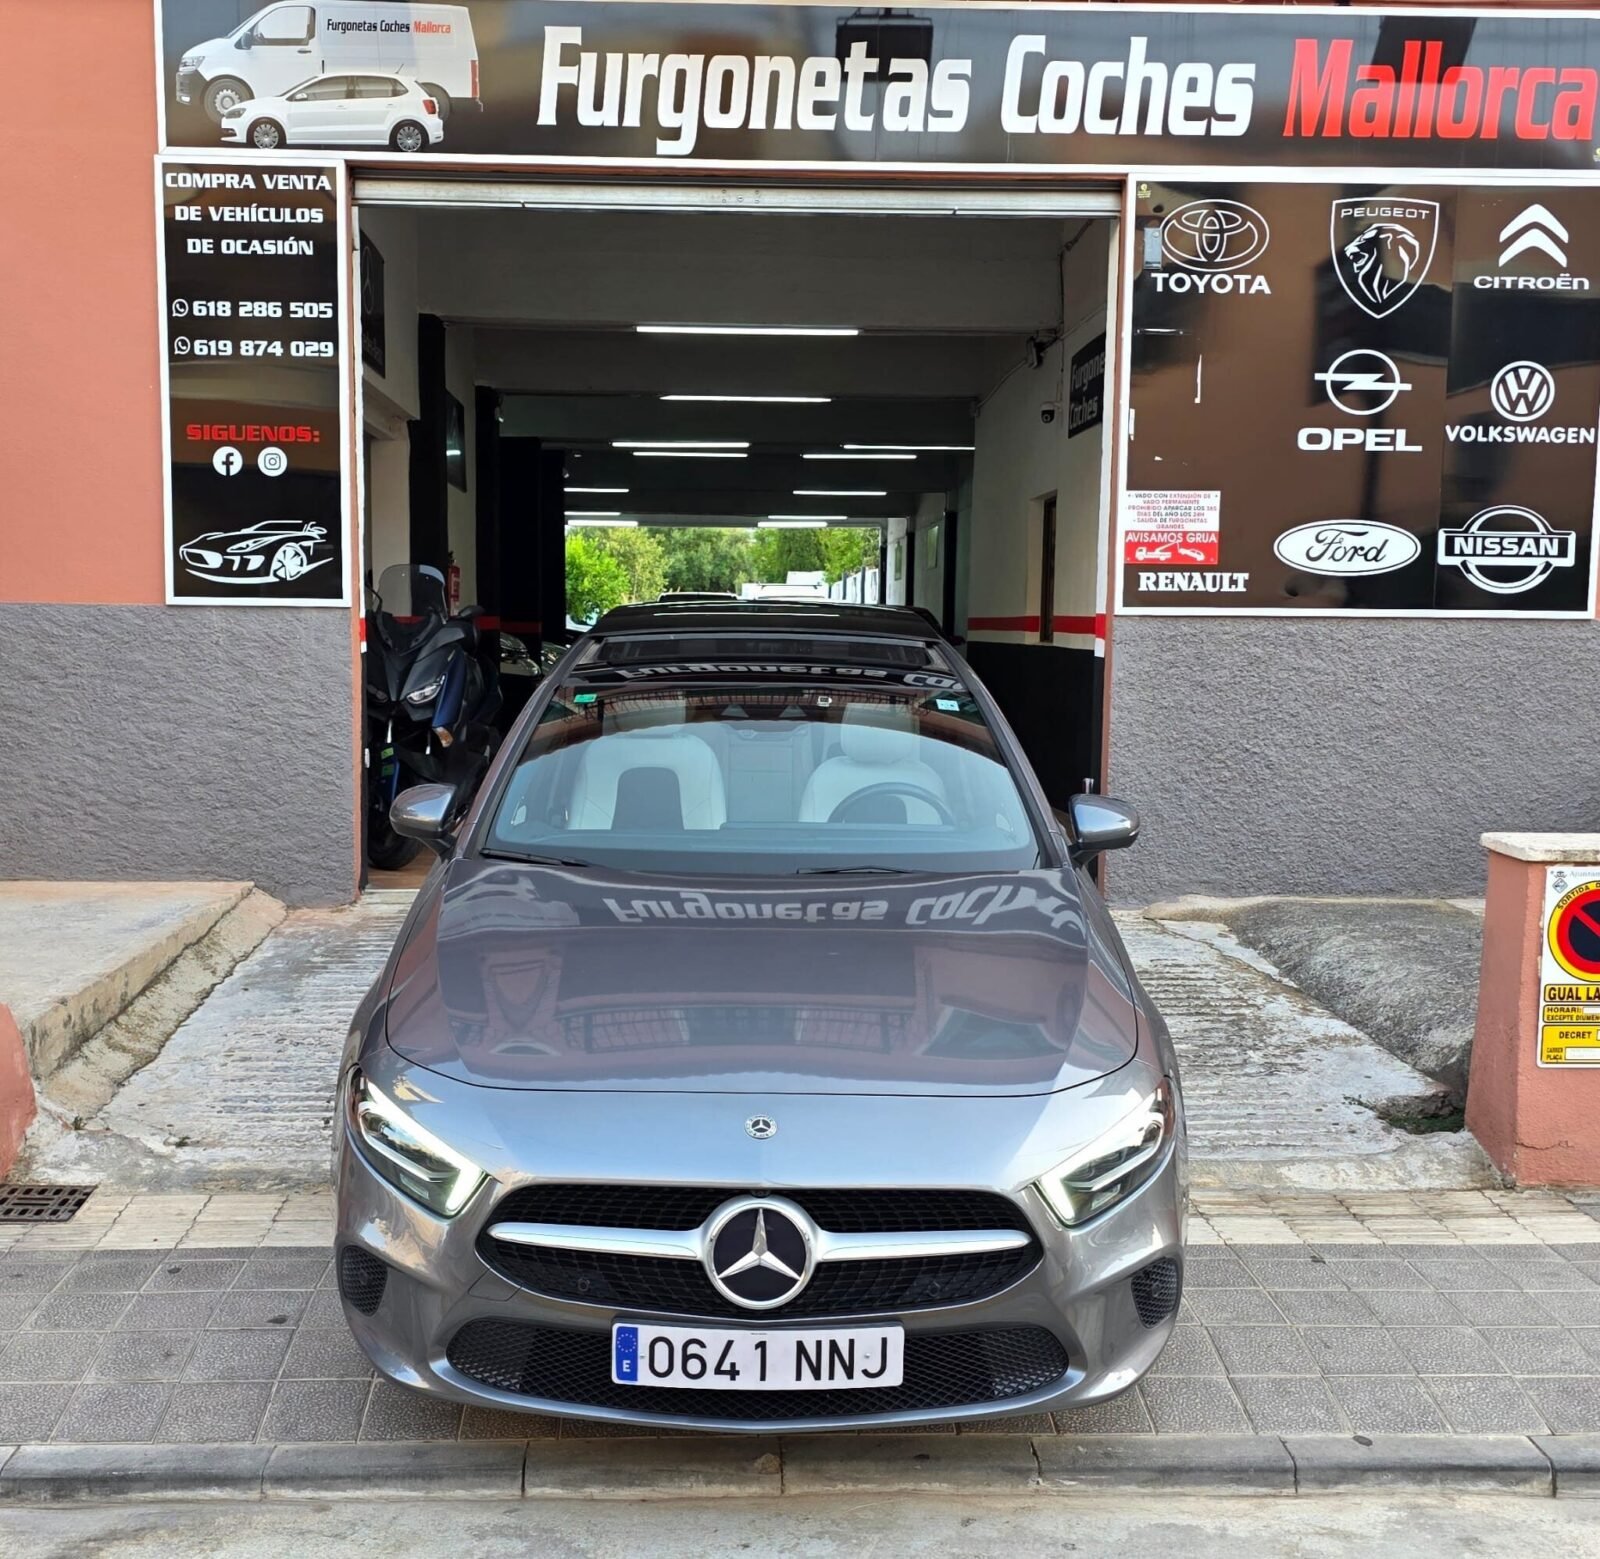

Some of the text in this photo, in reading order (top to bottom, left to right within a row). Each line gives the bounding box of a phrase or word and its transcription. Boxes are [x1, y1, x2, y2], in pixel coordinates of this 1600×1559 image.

[327, 19, 451, 34] Furgonetas Coches Mallorca
[536, 25, 1597, 156] Furgonetas Coches Mallorca
[165, 172, 332, 191] COMPRA VENTA
[174, 203, 324, 224] DE VEHÍCULOS
[1341, 207, 1430, 220] PEUGEOT
[187, 236, 314, 256] DE OCASIÓN
[1150, 272, 1272, 295] TOYOTA
[192, 301, 333, 319] 618 286 505
[193, 340, 334, 357] 619 874 029
[186, 424, 321, 442] SIGUENOS:
[1297, 427, 1423, 453] OPEL
[1445, 424, 1596, 444] VOLKSWAGEN
[1125, 532, 1218, 543] AVISAMOS GRUA
[1306, 528, 1389, 563] Ford
[1454, 536, 1558, 557] NISSAN
[1138, 572, 1249, 593] RENAULT
[1557, 885, 1590, 910] SORTIDA
[1548, 986, 1582, 1001] GUAL
[1558, 1031, 1592, 1039] DECRET
[623, 1360, 630, 1372] E
[648, 1336, 888, 1381] 0641 NNJ
